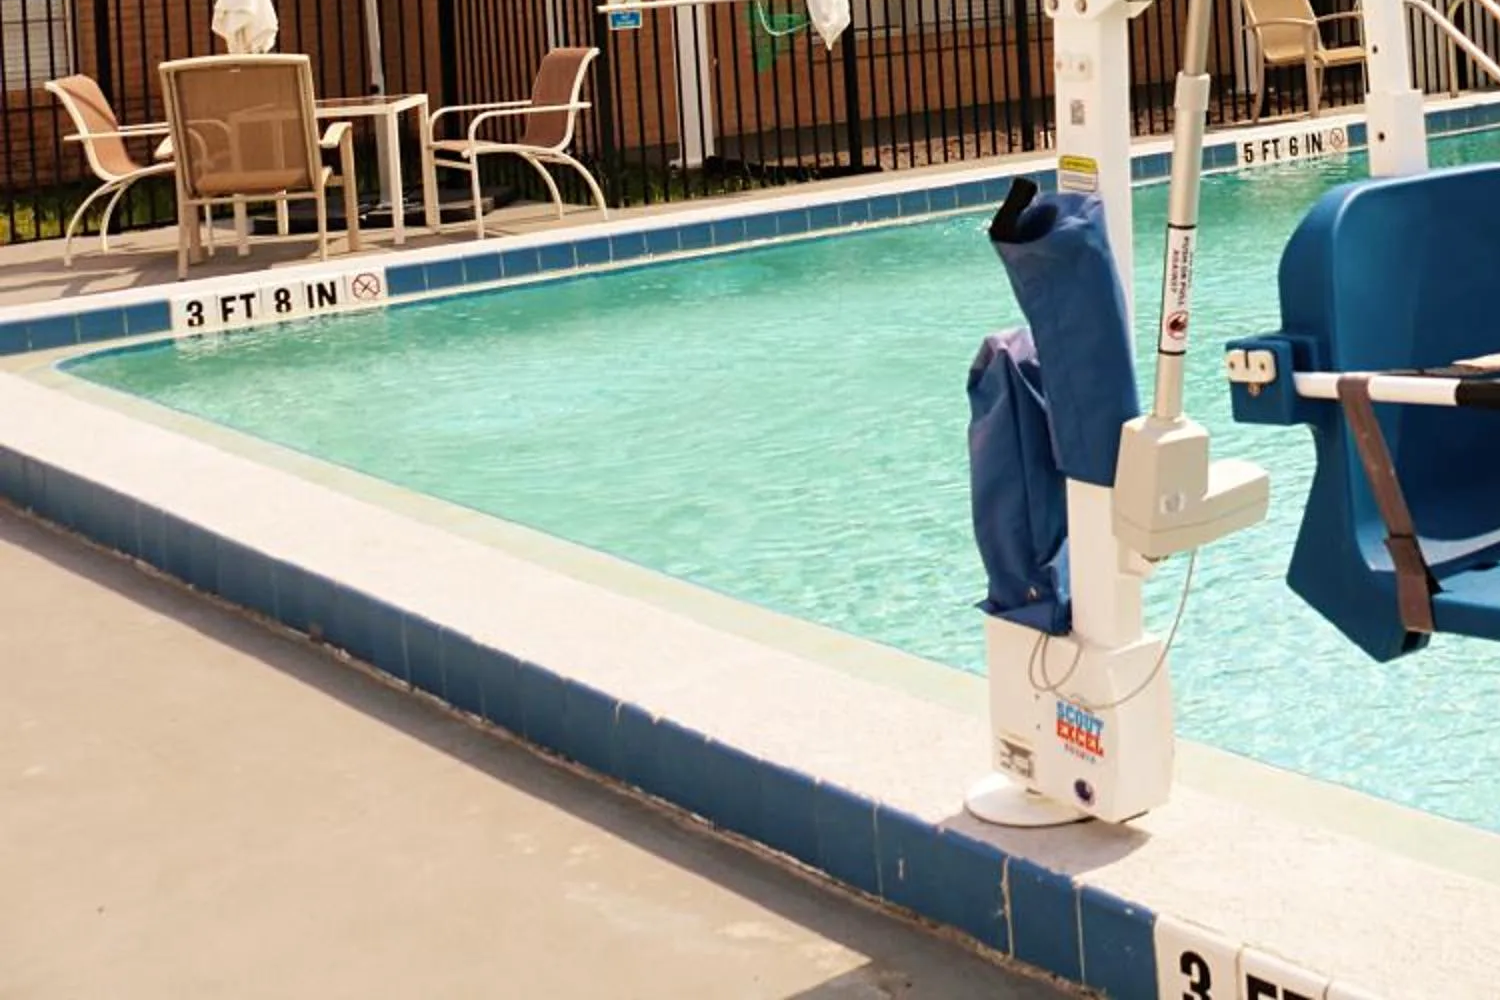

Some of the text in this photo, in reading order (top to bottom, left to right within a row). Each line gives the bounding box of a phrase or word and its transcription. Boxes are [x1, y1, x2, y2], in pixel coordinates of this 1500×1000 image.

[1243, 142, 1255, 163] 5
[1289, 136, 1299, 157] 6
[186, 281, 338, 327] 3 FT 8 IN
[1055, 700, 1104, 737] SCOUT
[1056, 718, 1104, 758] EXCEL
